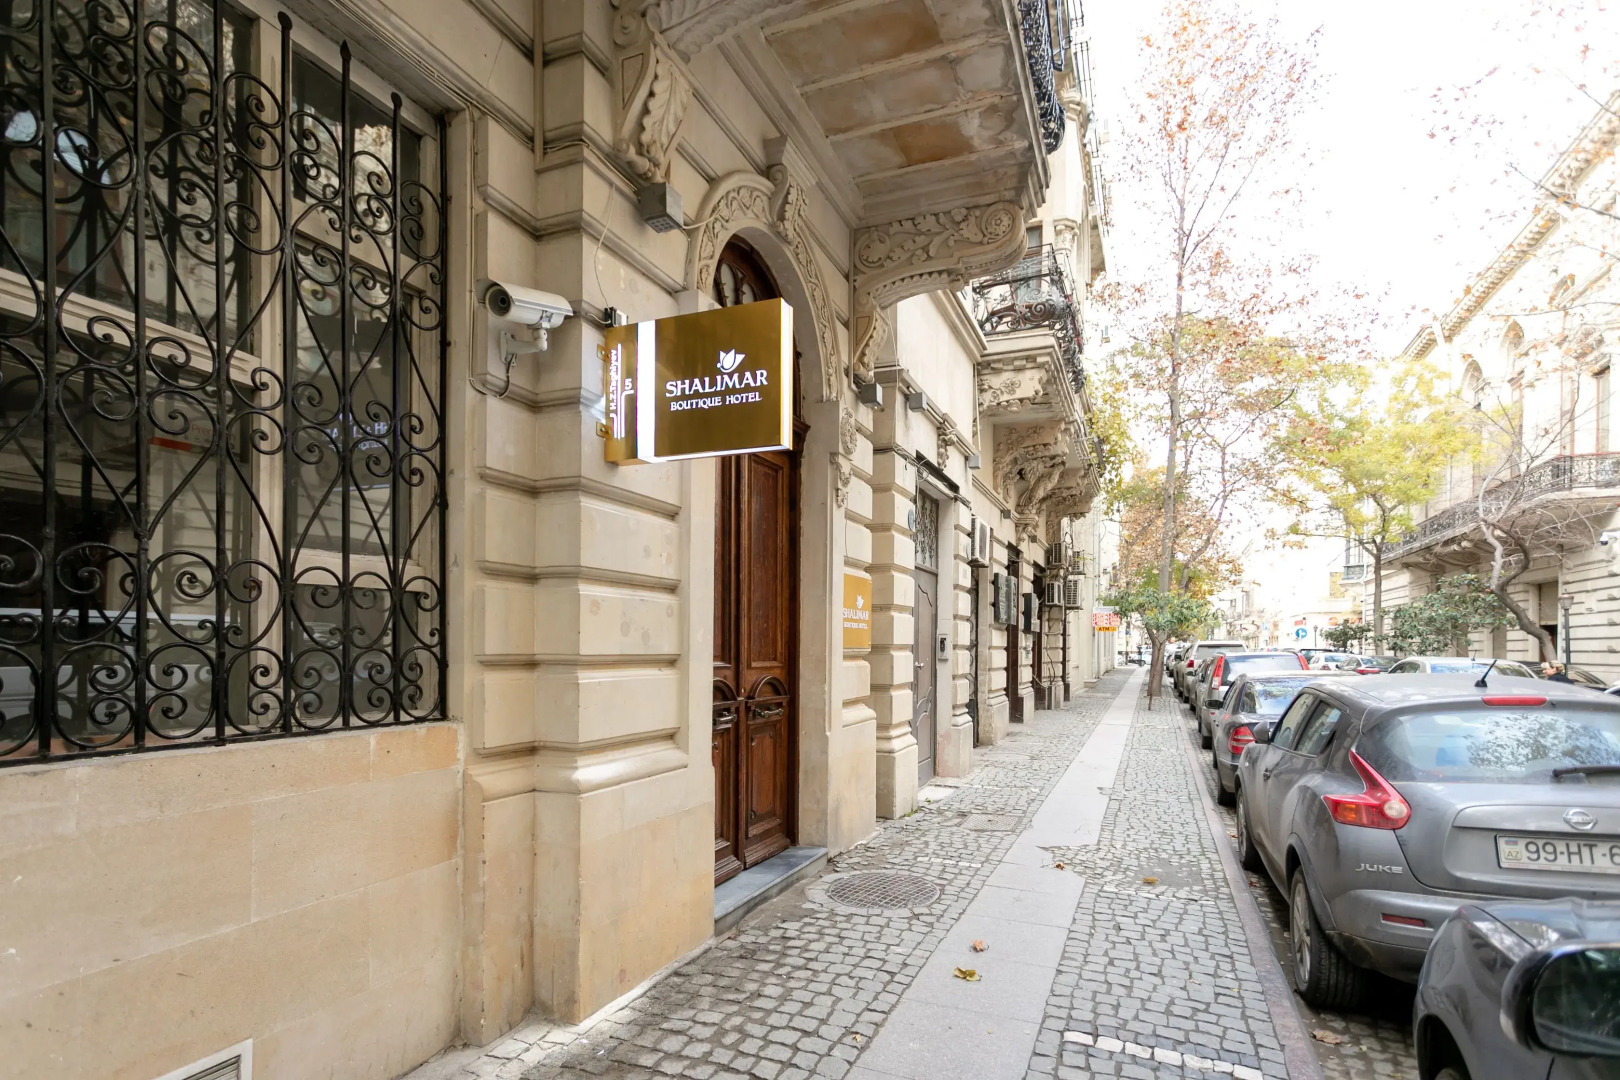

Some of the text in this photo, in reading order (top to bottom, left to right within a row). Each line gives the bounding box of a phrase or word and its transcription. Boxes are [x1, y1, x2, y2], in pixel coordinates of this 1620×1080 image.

[624, 378, 633, 390] 5
[665, 369, 768, 397] SHALIMAR
[670, 391, 762, 411] BOUTIQUE HOTEL
[1506, 850, 1520, 859] AZ
[1353, 863, 1404, 874] JUKE
